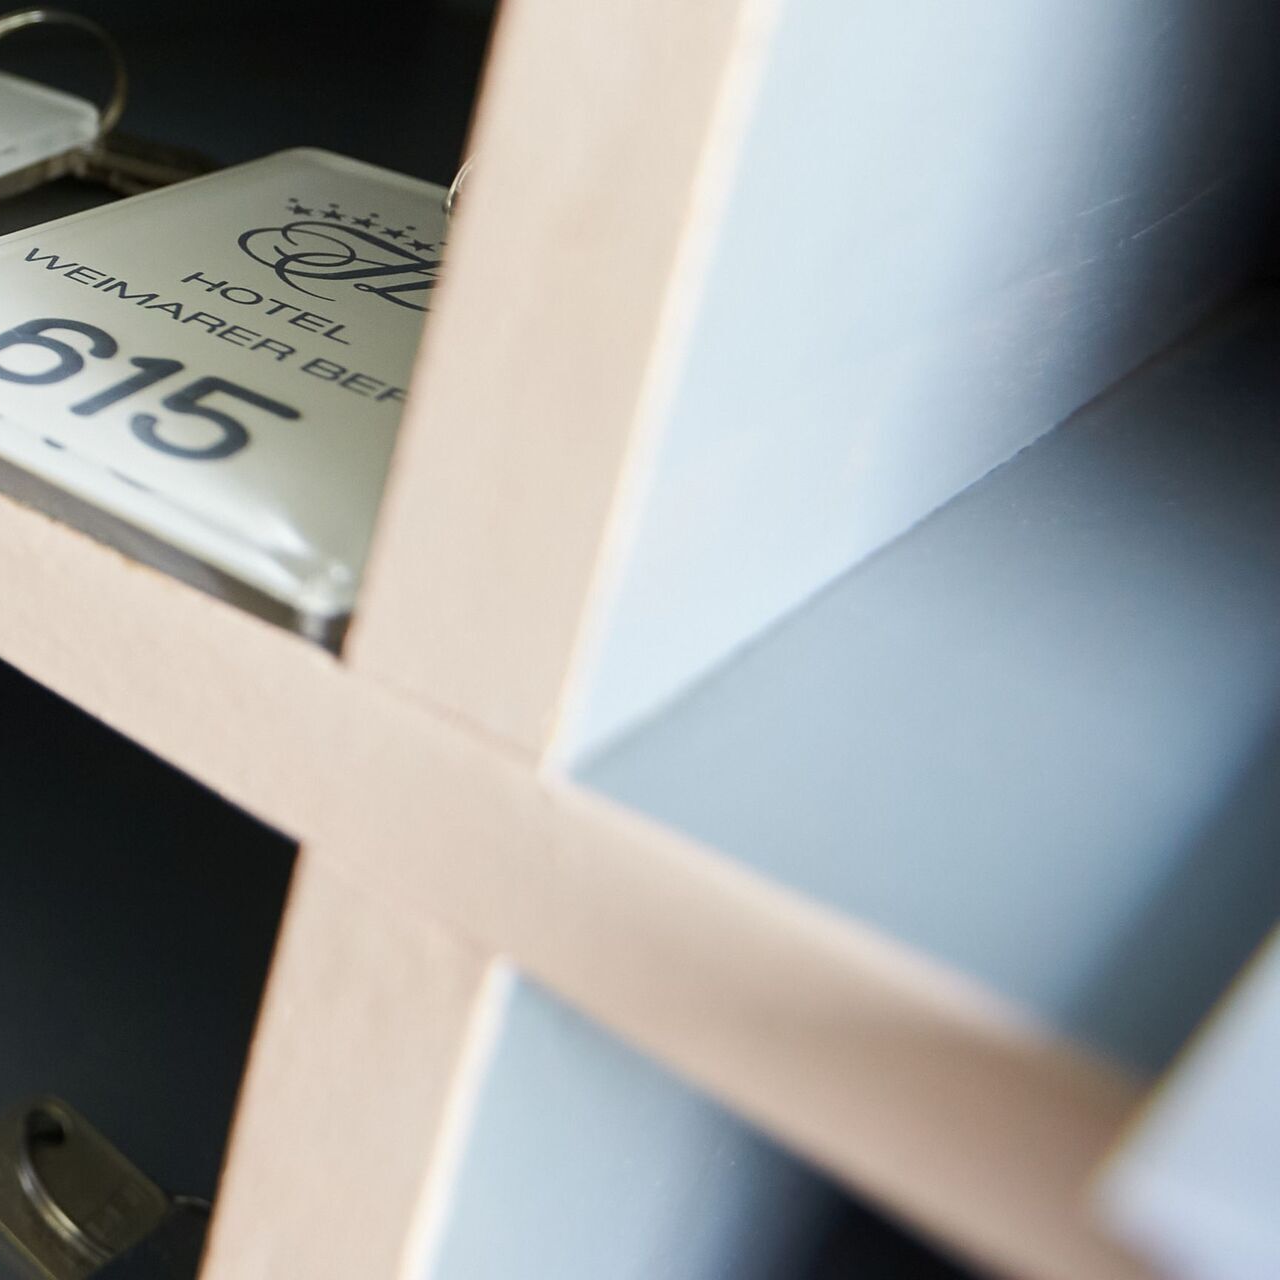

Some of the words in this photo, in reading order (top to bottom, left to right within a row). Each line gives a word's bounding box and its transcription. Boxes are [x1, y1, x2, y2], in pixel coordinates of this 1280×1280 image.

[25, 247, 297, 362] WEIMARER
[301, 357, 410, 403] BER
[181, 271, 351, 346] HOTEL
